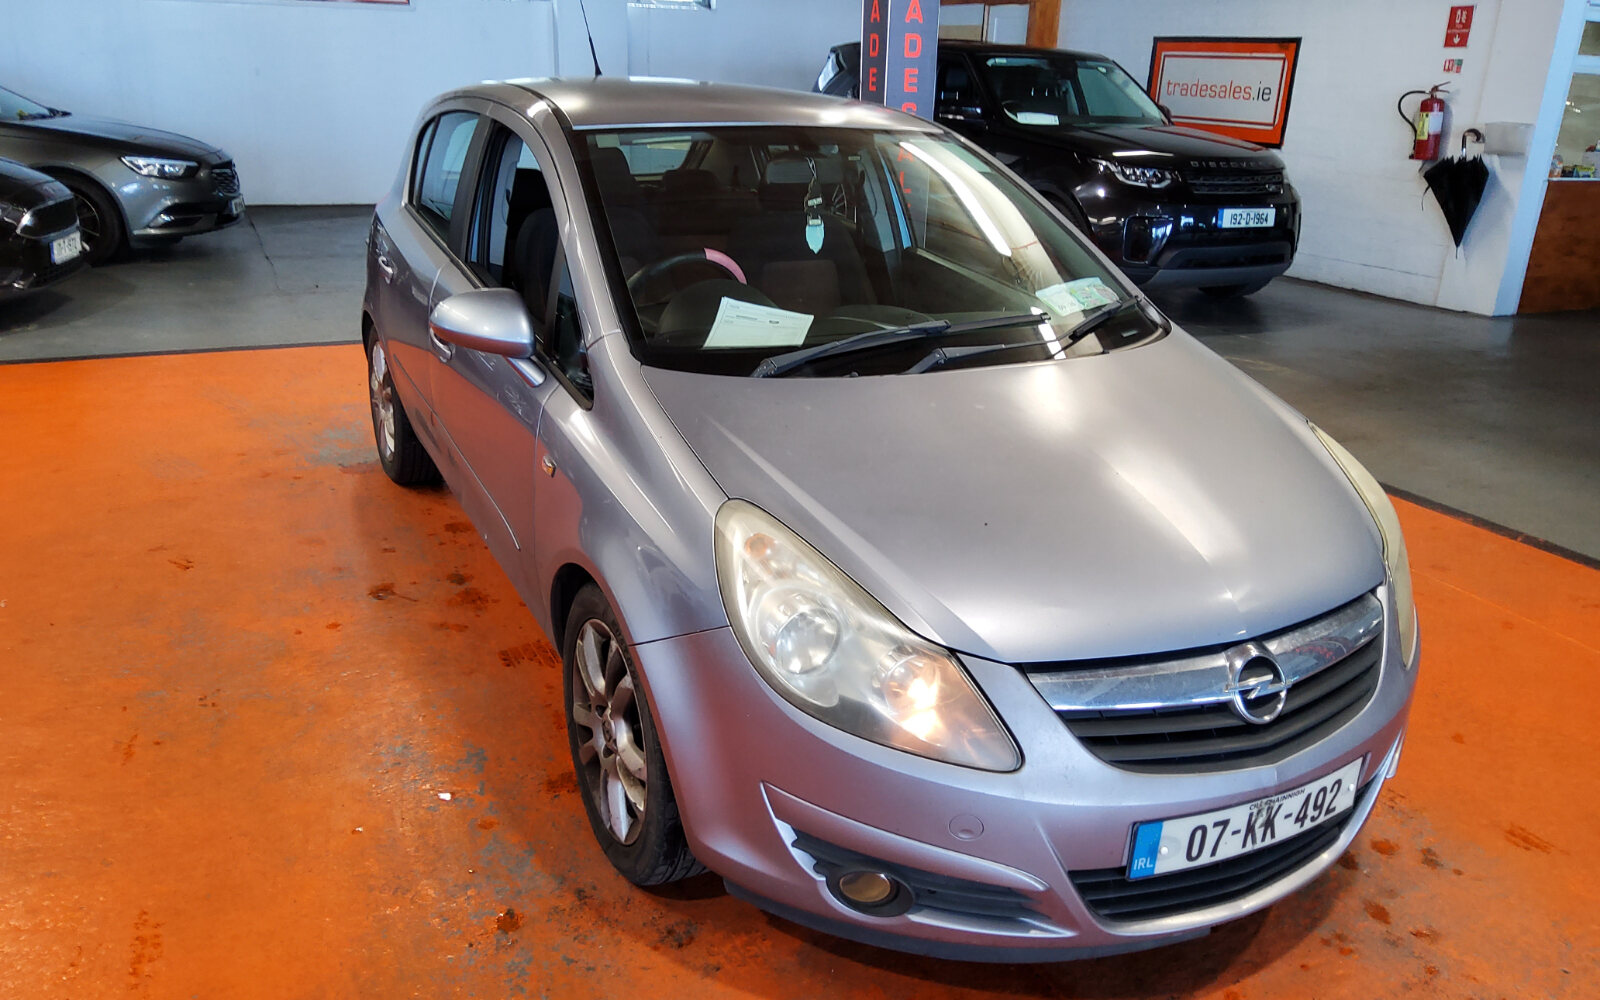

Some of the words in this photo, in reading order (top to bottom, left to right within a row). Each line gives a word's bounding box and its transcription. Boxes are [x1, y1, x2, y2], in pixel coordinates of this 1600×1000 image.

[1166, 77, 1272, 102] tradesales.ie
[1230, 212, 1269, 225] 192-D-1964
[1185, 778, 1343, 863] 07-KK-492
[1133, 858, 1154, 871] IRL
